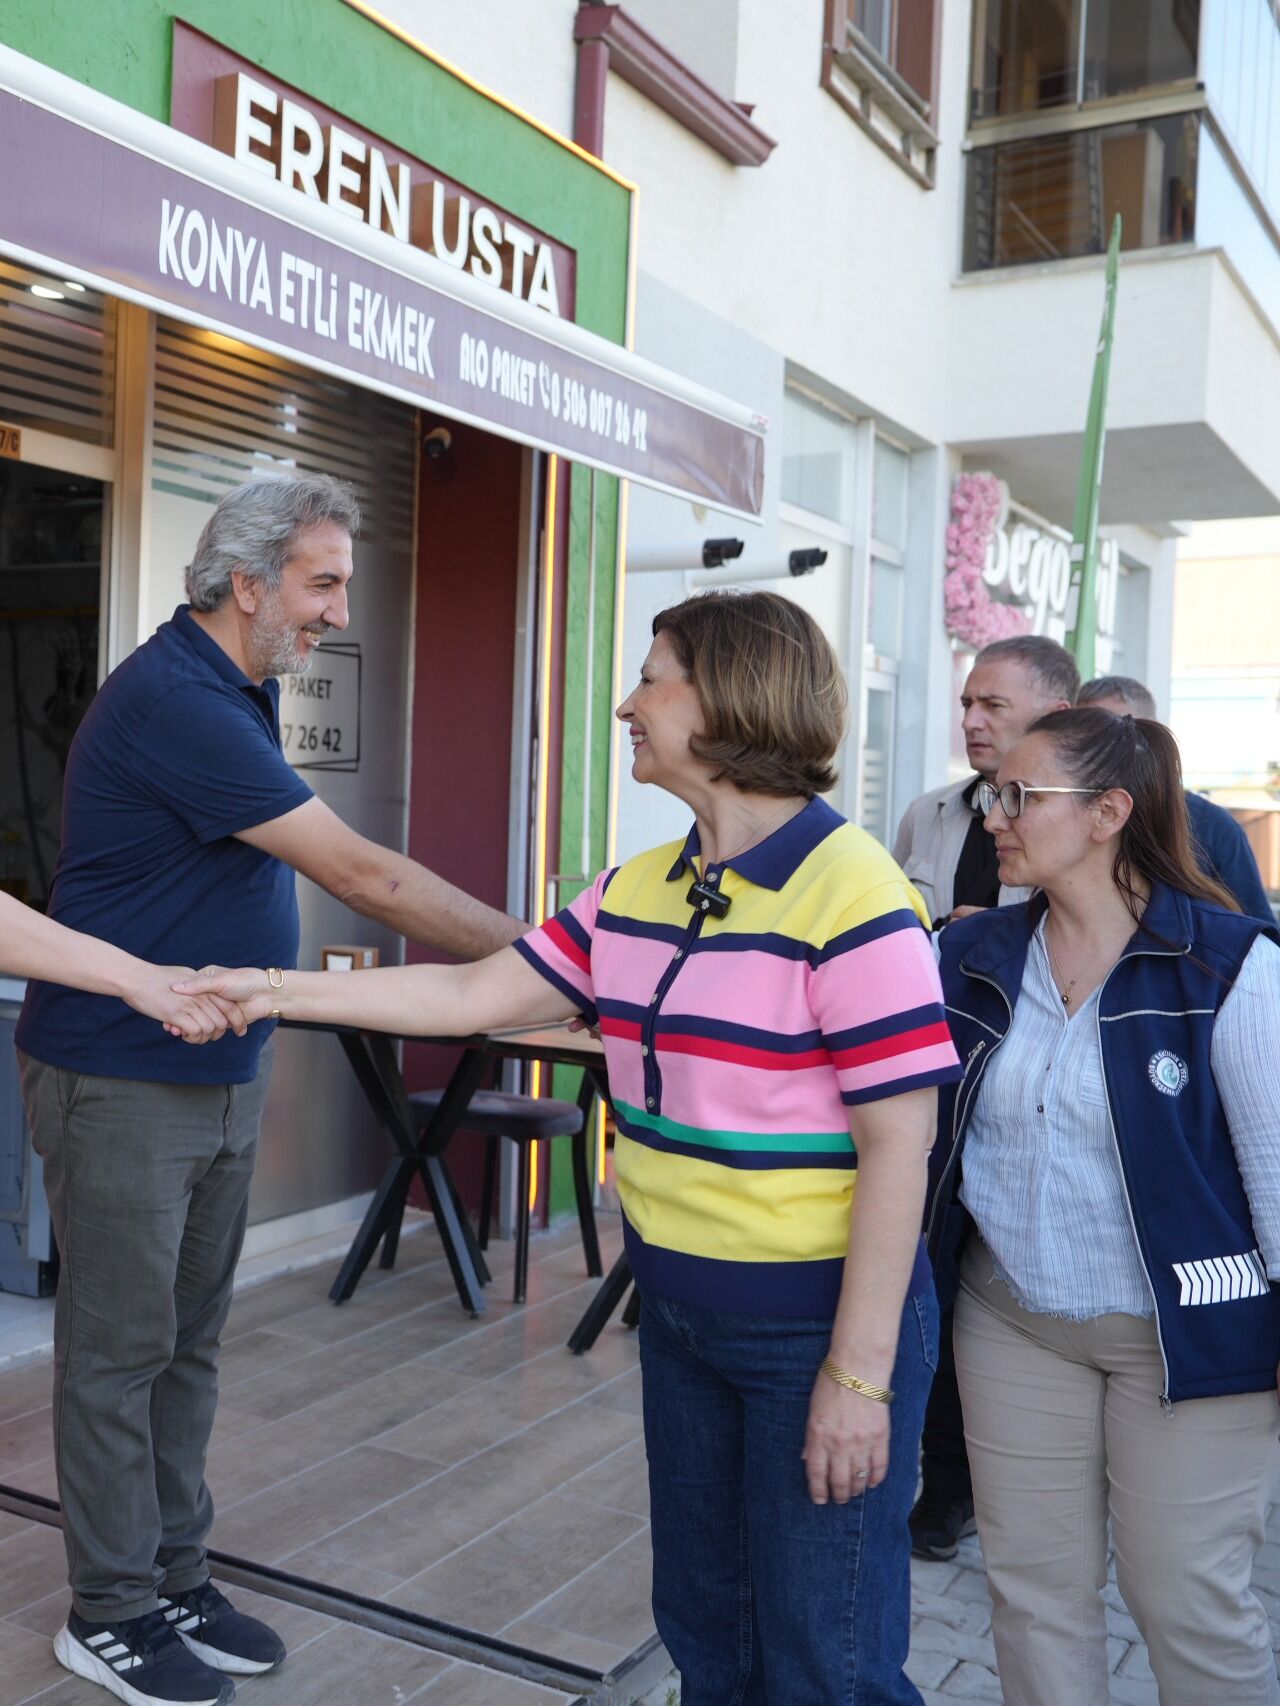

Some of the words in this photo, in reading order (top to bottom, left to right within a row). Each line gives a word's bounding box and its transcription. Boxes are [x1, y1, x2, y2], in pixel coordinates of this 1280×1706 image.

[234, 71, 411, 245] EREN
[432, 180, 560, 318] USTA
[159, 198, 273, 316] KONYA
[348, 280, 436, 379] EKMEK
[459, 332, 489, 389] ALO
[491, 346, 536, 408] PAKET
[563, 378, 587, 429] 506
[589, 388, 613, 438] 007
[614, 399, 630, 446] 26
[632, 407, 647, 452] 42
[288, 676, 333, 700] PAKET
[298, 725, 318, 750] 26
[322, 727, 342, 752] 42
